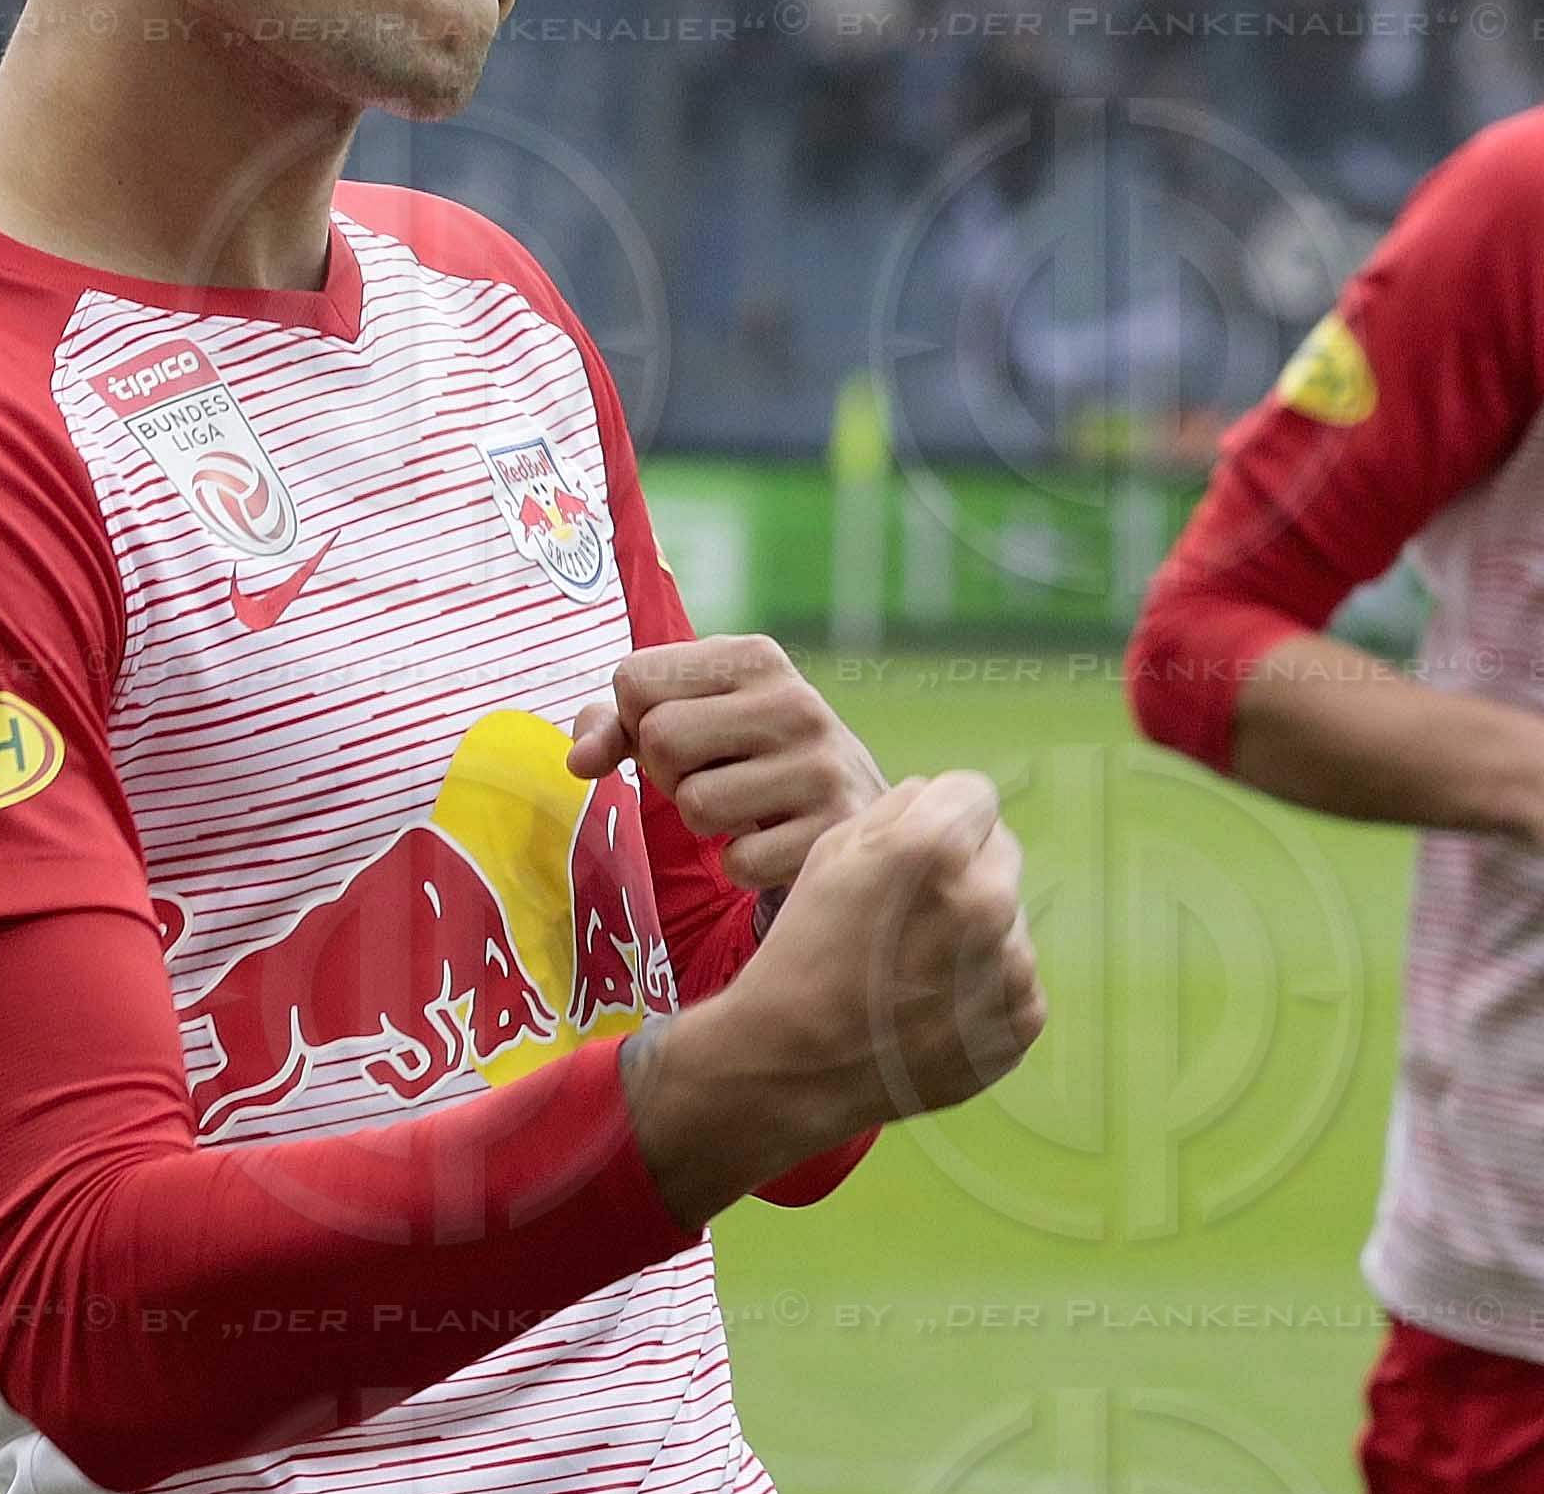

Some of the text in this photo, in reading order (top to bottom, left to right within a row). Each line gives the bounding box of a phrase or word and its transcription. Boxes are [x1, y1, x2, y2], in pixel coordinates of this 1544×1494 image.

[107, 350, 200, 401] tipico
[137, 394, 230, 441] BUNDES
[171, 423, 225, 452] LIGA
